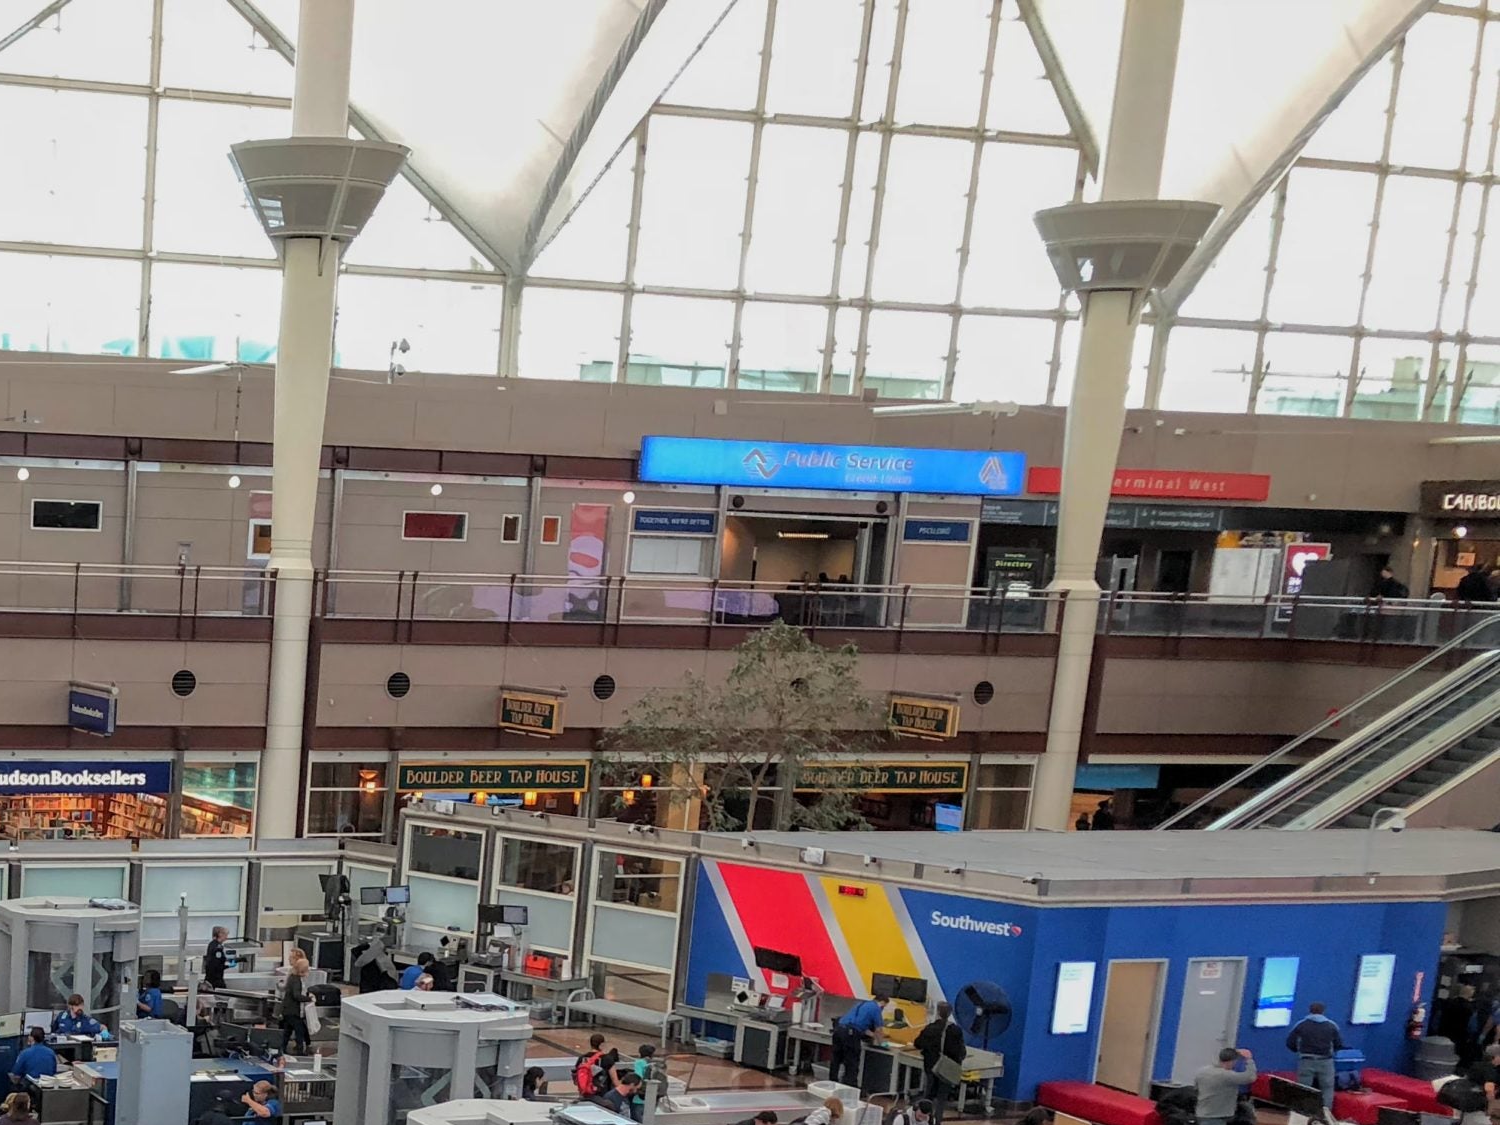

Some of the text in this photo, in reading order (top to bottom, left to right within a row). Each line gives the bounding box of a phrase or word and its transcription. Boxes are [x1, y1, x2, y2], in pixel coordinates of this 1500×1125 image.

[784, 450, 914, 472] Public Service
[1113, 478, 1226, 491] erminal West
[995, 559, 1033, 570] Directory
[406, 769, 579, 785] BOULDER BEER TAP HOUSE
[895, 770, 916, 785] TAP
[918, 770, 958, 785] HOUSE
[930, 910, 1011, 937] Southwest
